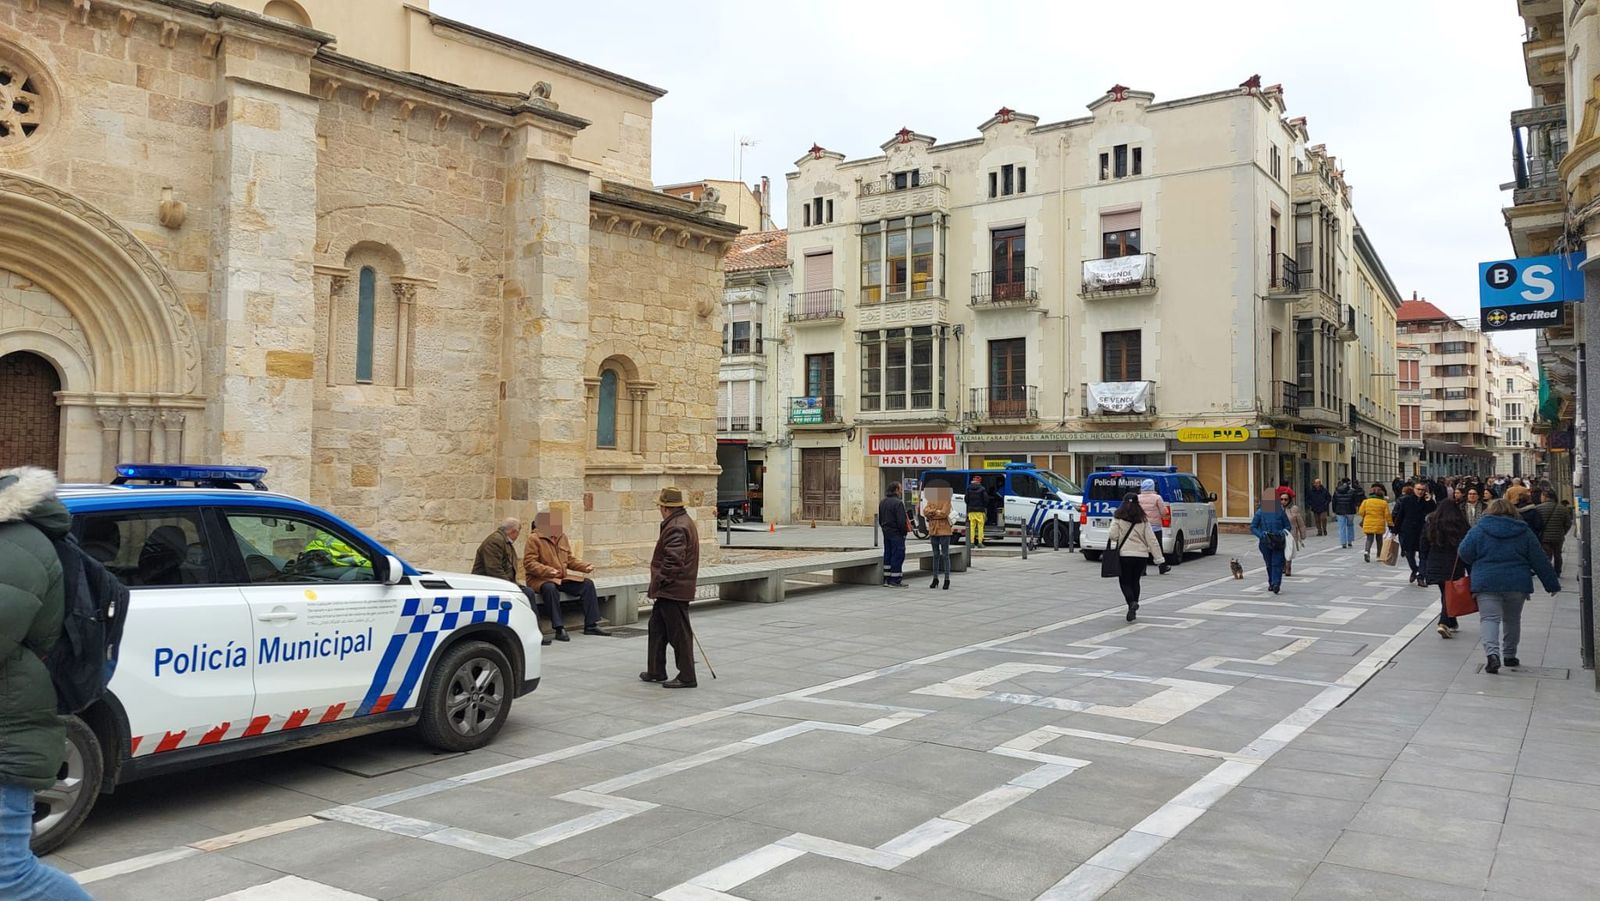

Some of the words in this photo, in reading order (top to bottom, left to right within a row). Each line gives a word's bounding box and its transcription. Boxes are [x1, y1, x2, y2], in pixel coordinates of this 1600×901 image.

[1108, 270, 1131, 278] VENDE
[1494, 268, 1509, 284] B
[1520, 264, 1555, 301] S
[1509, 309, 1558, 321] ServiRed
[872, 436, 925, 452] LIQUIDACIÓN
[927, 437, 953, 451] TOTAL
[882, 456, 919, 464] HASTA
[921, 456, 943, 464] 50%
[1173, 489, 1184, 501] 112
[1086, 502, 1109, 513] 112
[155, 641, 247, 677] Policía
[258, 627, 373, 664] Municipal
